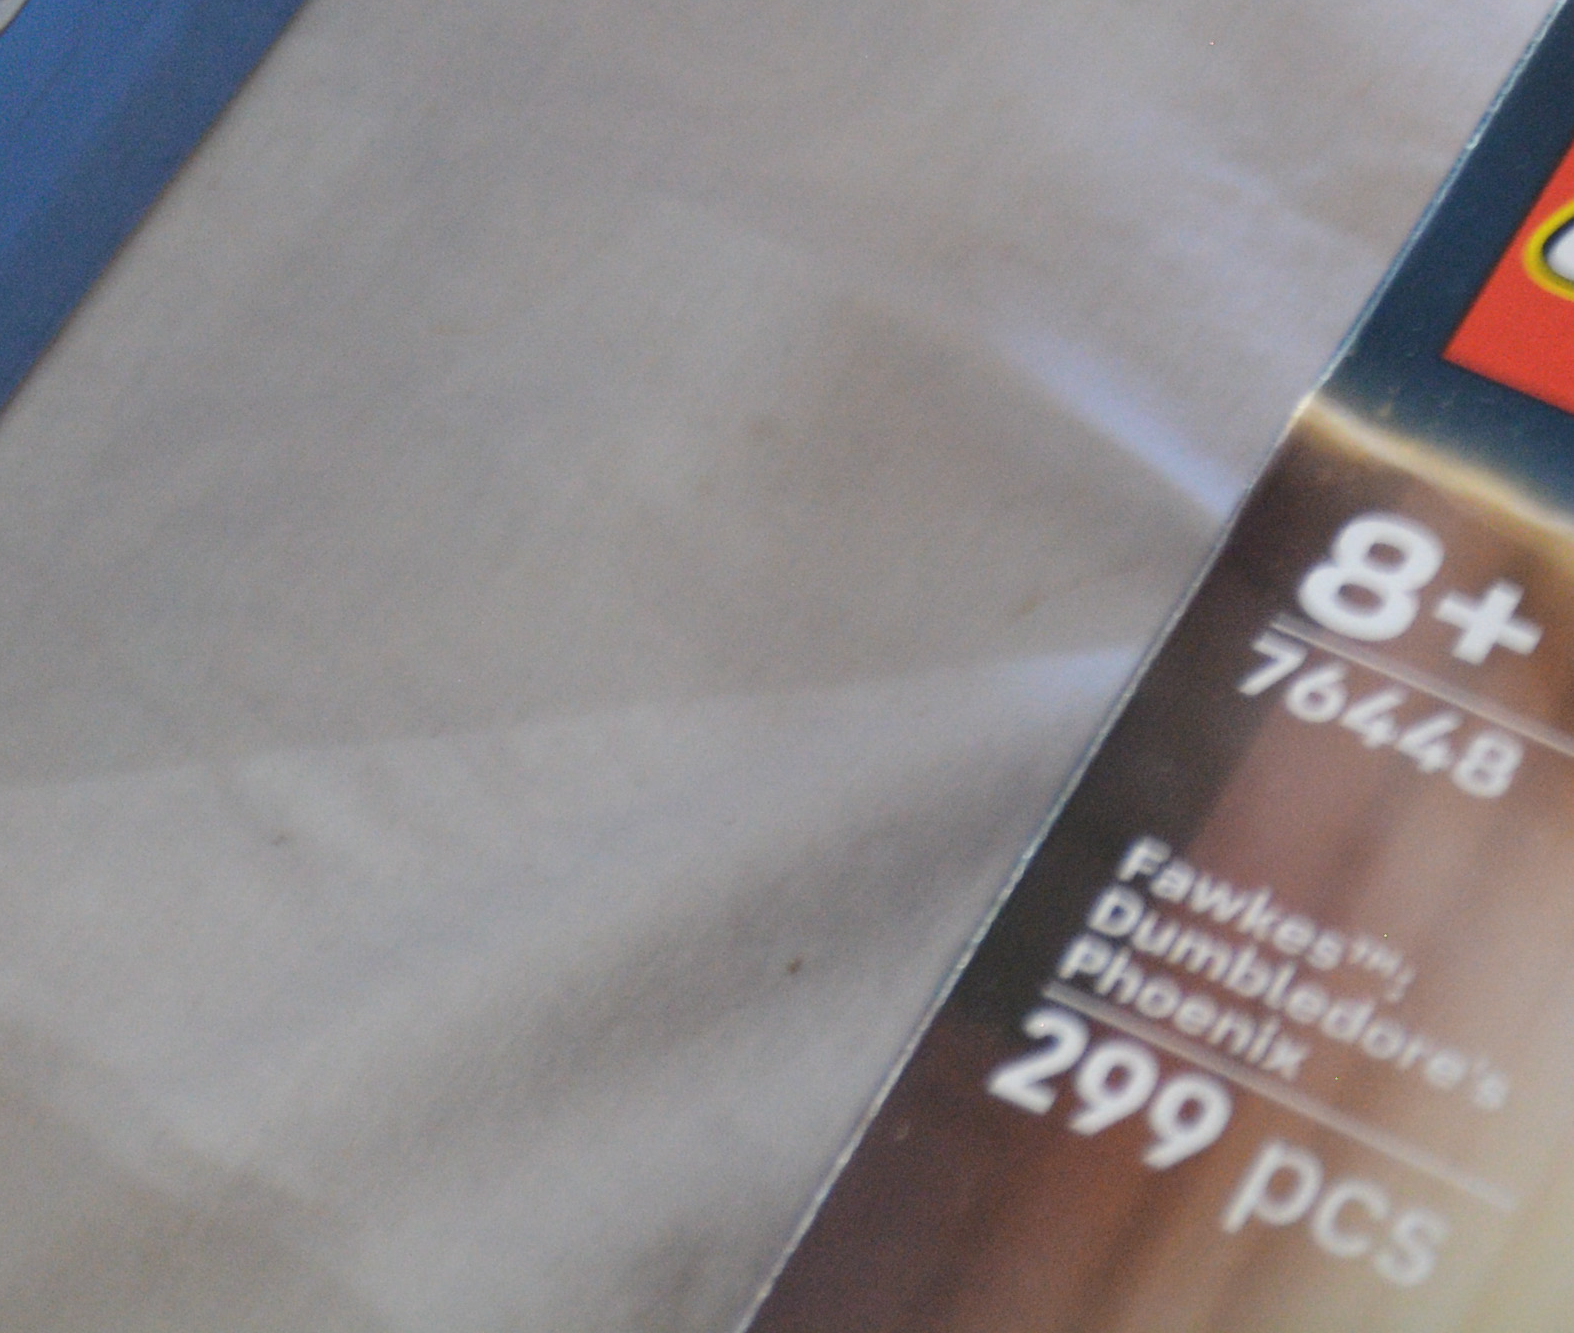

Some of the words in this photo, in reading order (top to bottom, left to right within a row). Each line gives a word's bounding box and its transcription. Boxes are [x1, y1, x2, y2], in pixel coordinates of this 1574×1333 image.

[1297, 512, 1542, 670] 8+
[1237, 630, 1524, 802] 76448
[1057, 939, 1315, 1084] Phoenix
[988, 1006, 1232, 1173] 299
[1219, 1138, 1449, 1293] pcs
